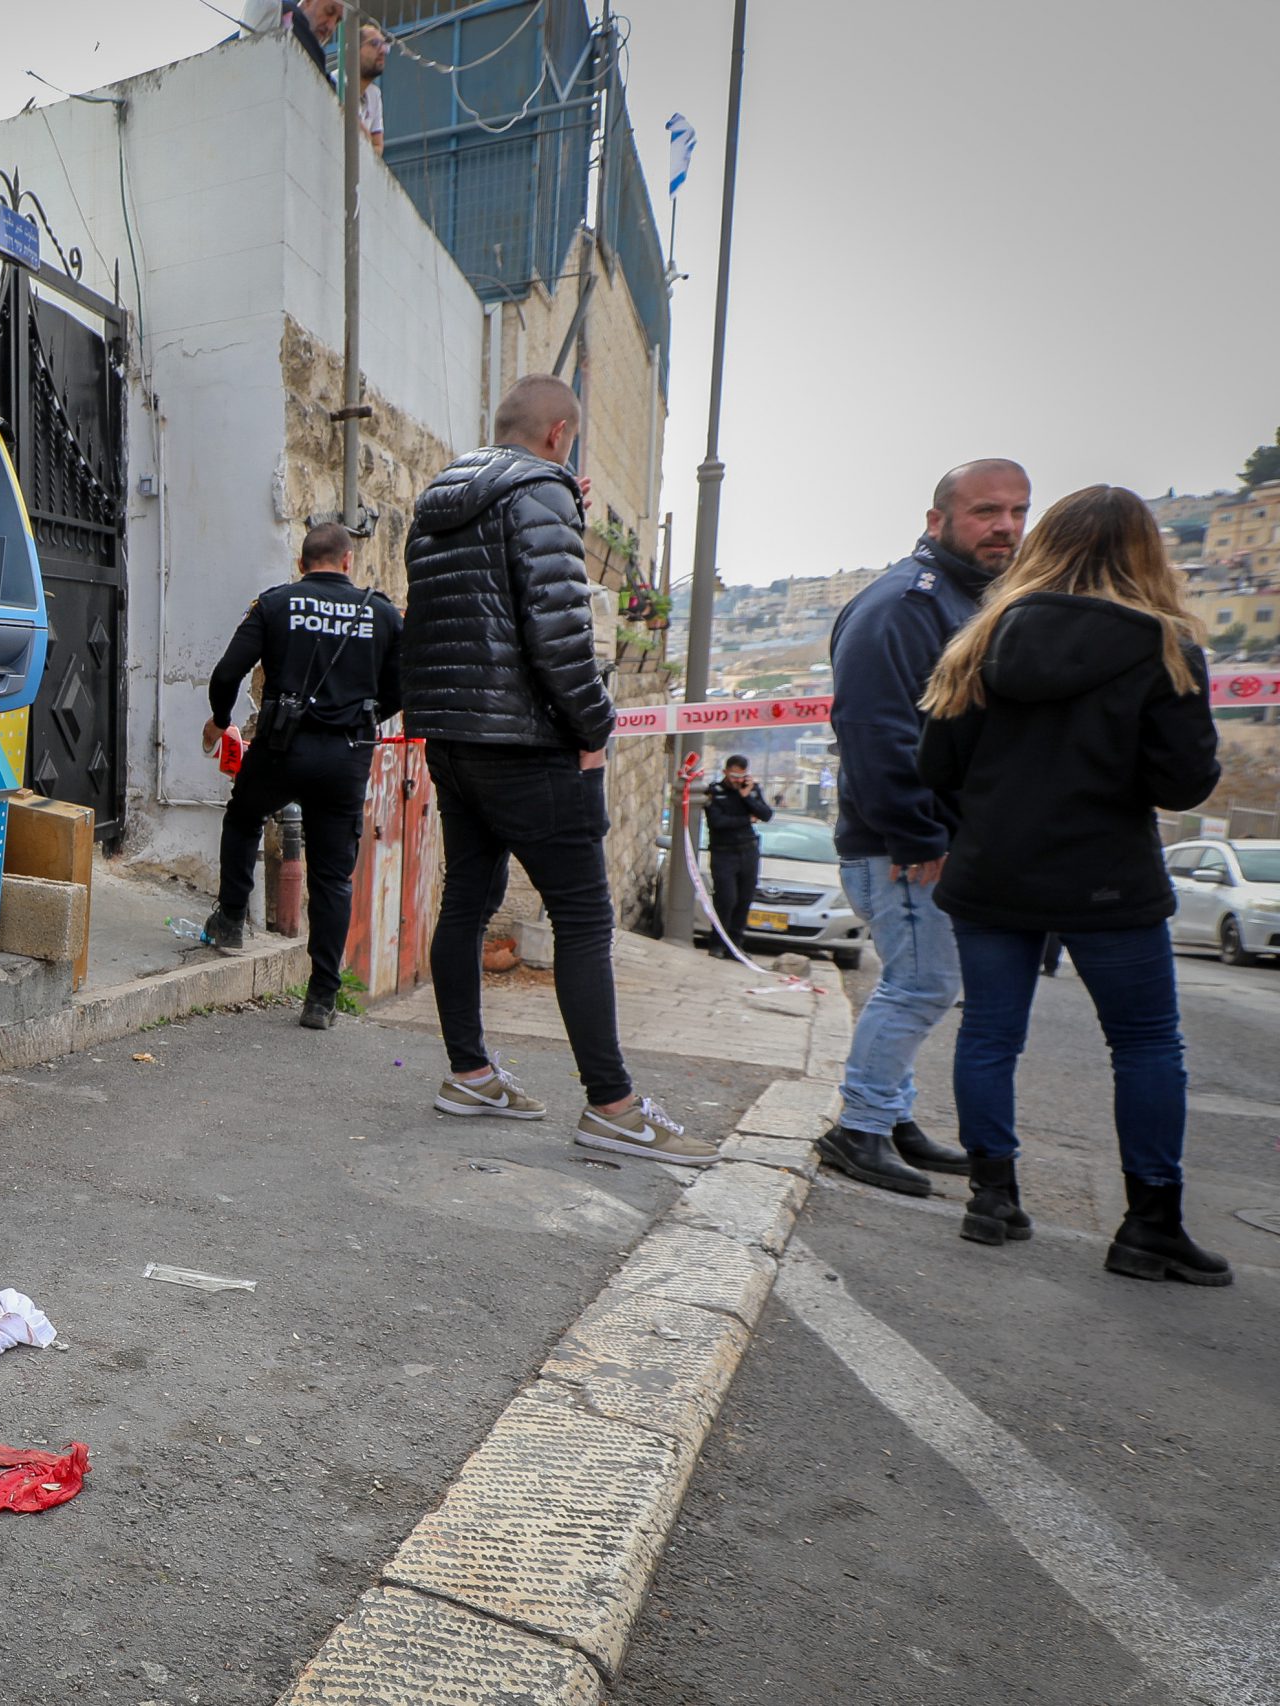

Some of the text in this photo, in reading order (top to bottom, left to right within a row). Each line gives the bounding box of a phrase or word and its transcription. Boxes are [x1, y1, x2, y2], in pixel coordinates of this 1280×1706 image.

[290, 597, 374, 619] משטרה
[290, 614, 374, 638] POLICE
[617, 702, 829, 727] ראל אין מעבר משט
